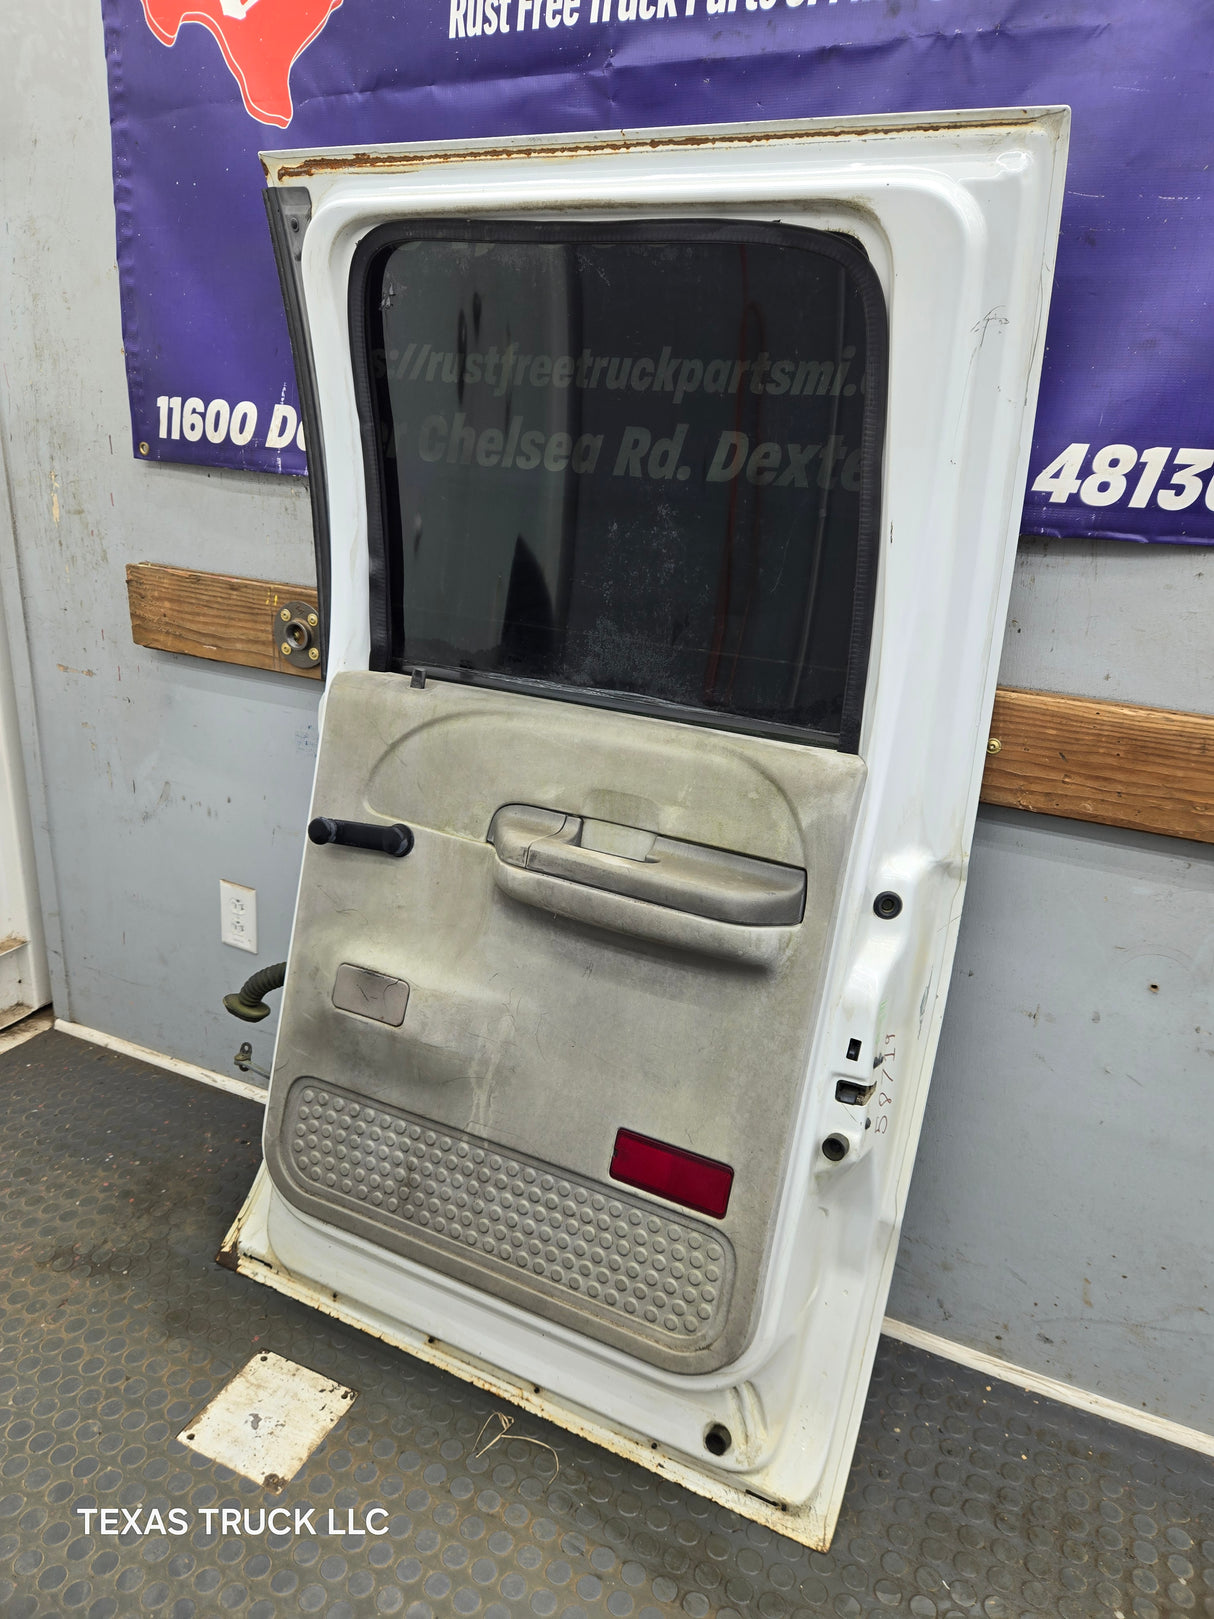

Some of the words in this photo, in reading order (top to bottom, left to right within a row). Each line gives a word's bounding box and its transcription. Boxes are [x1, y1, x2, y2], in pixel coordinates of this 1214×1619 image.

[448, 0, 511, 39] Rust
[517, 0, 580, 31] Free
[156, 395, 258, 446] 11600
[418, 412, 605, 474] Chelsea
[612, 423, 692, 480] Rd.
[1030, 442, 1214, 513] 4813
